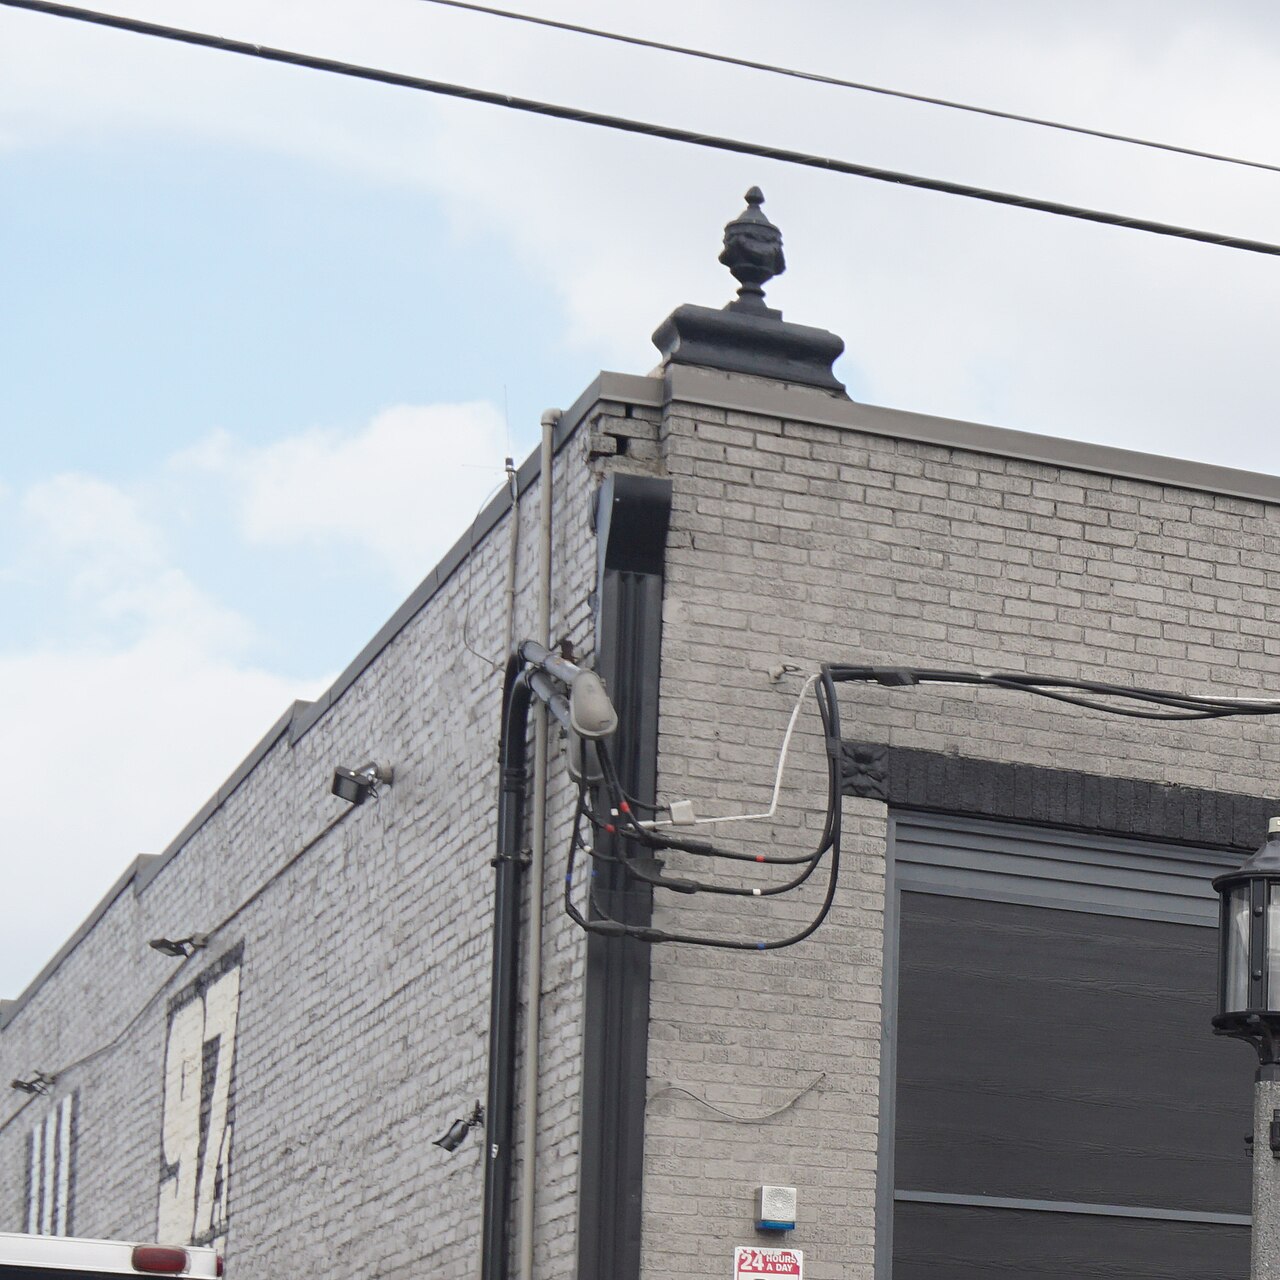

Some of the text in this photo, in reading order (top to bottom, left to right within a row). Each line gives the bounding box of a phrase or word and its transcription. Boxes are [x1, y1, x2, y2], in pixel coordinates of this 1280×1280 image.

[740, 1253, 796, 1271] 24 HOURS
[766, 1263, 793, 1272] A DAY
